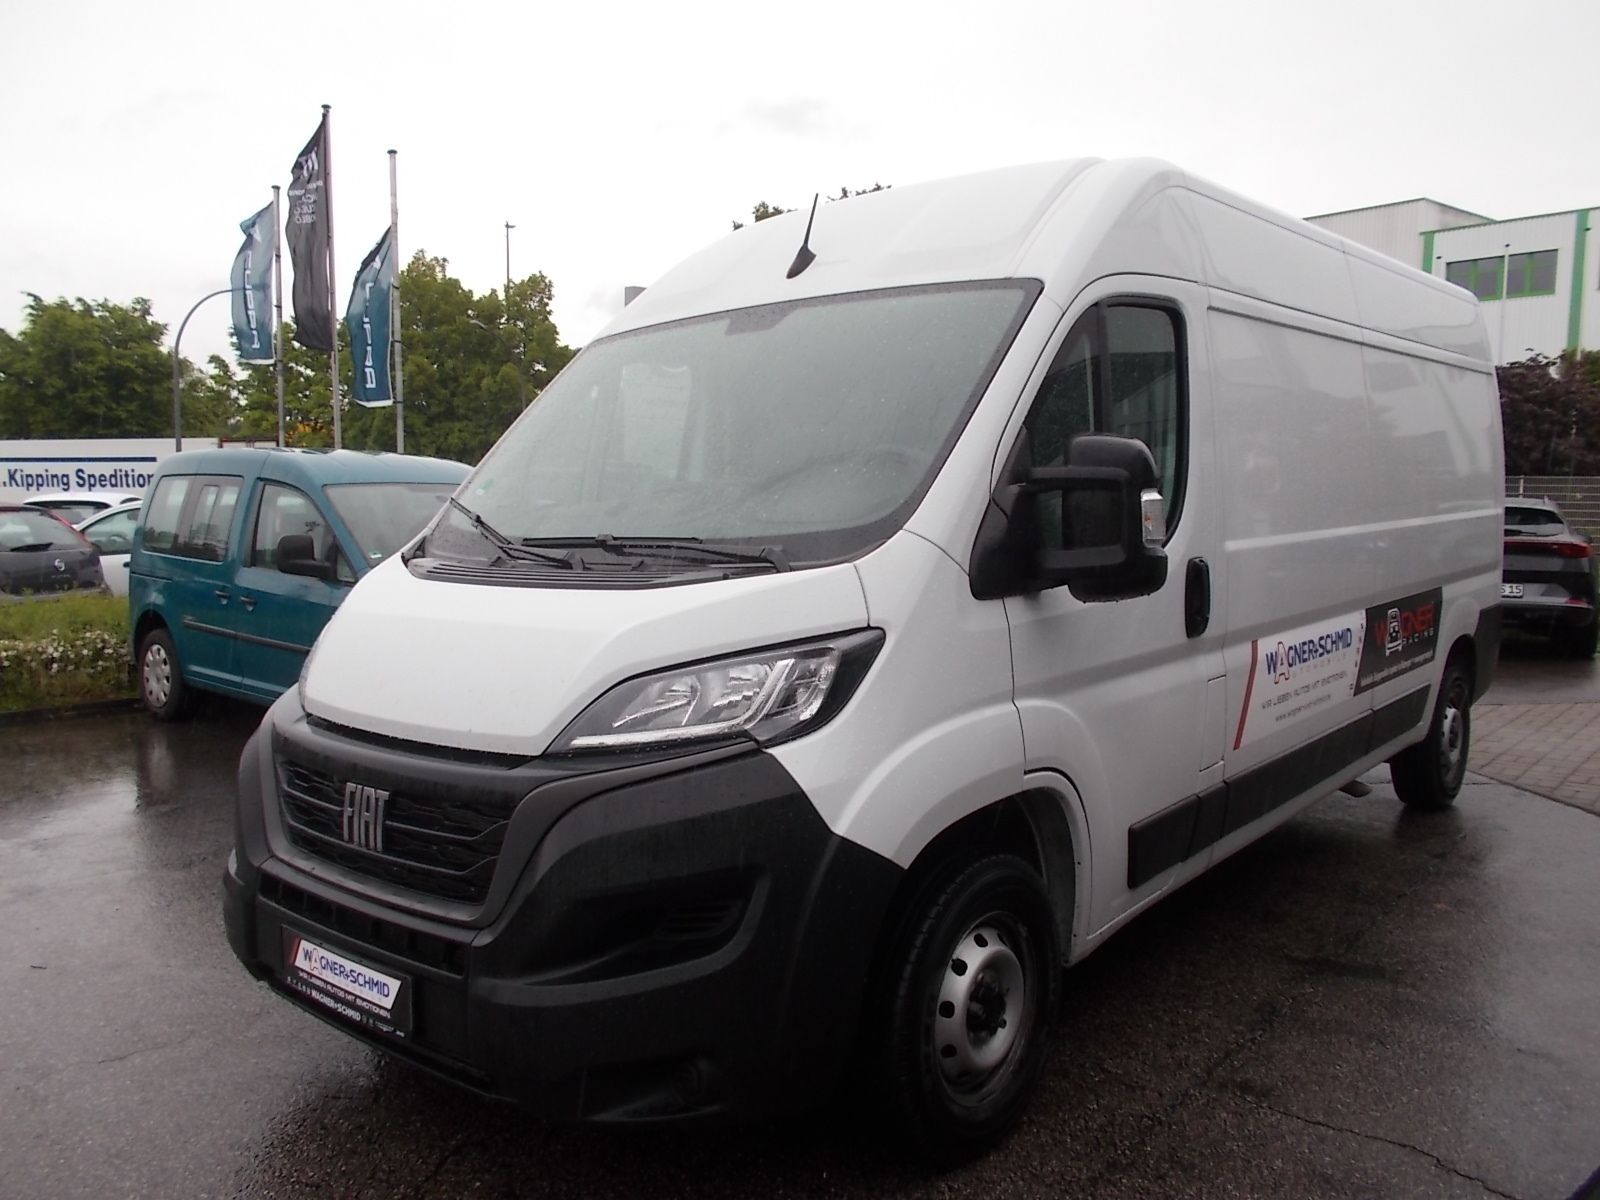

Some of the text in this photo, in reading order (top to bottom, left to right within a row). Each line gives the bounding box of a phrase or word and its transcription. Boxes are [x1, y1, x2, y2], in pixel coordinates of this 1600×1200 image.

[1509, 585, 1521, 594] 15
[1266, 628, 1352, 685] WAGNER+SCHMID
[343, 782, 390, 852] FIAT
[303, 947, 390, 998] WAGNER+SCHMID
